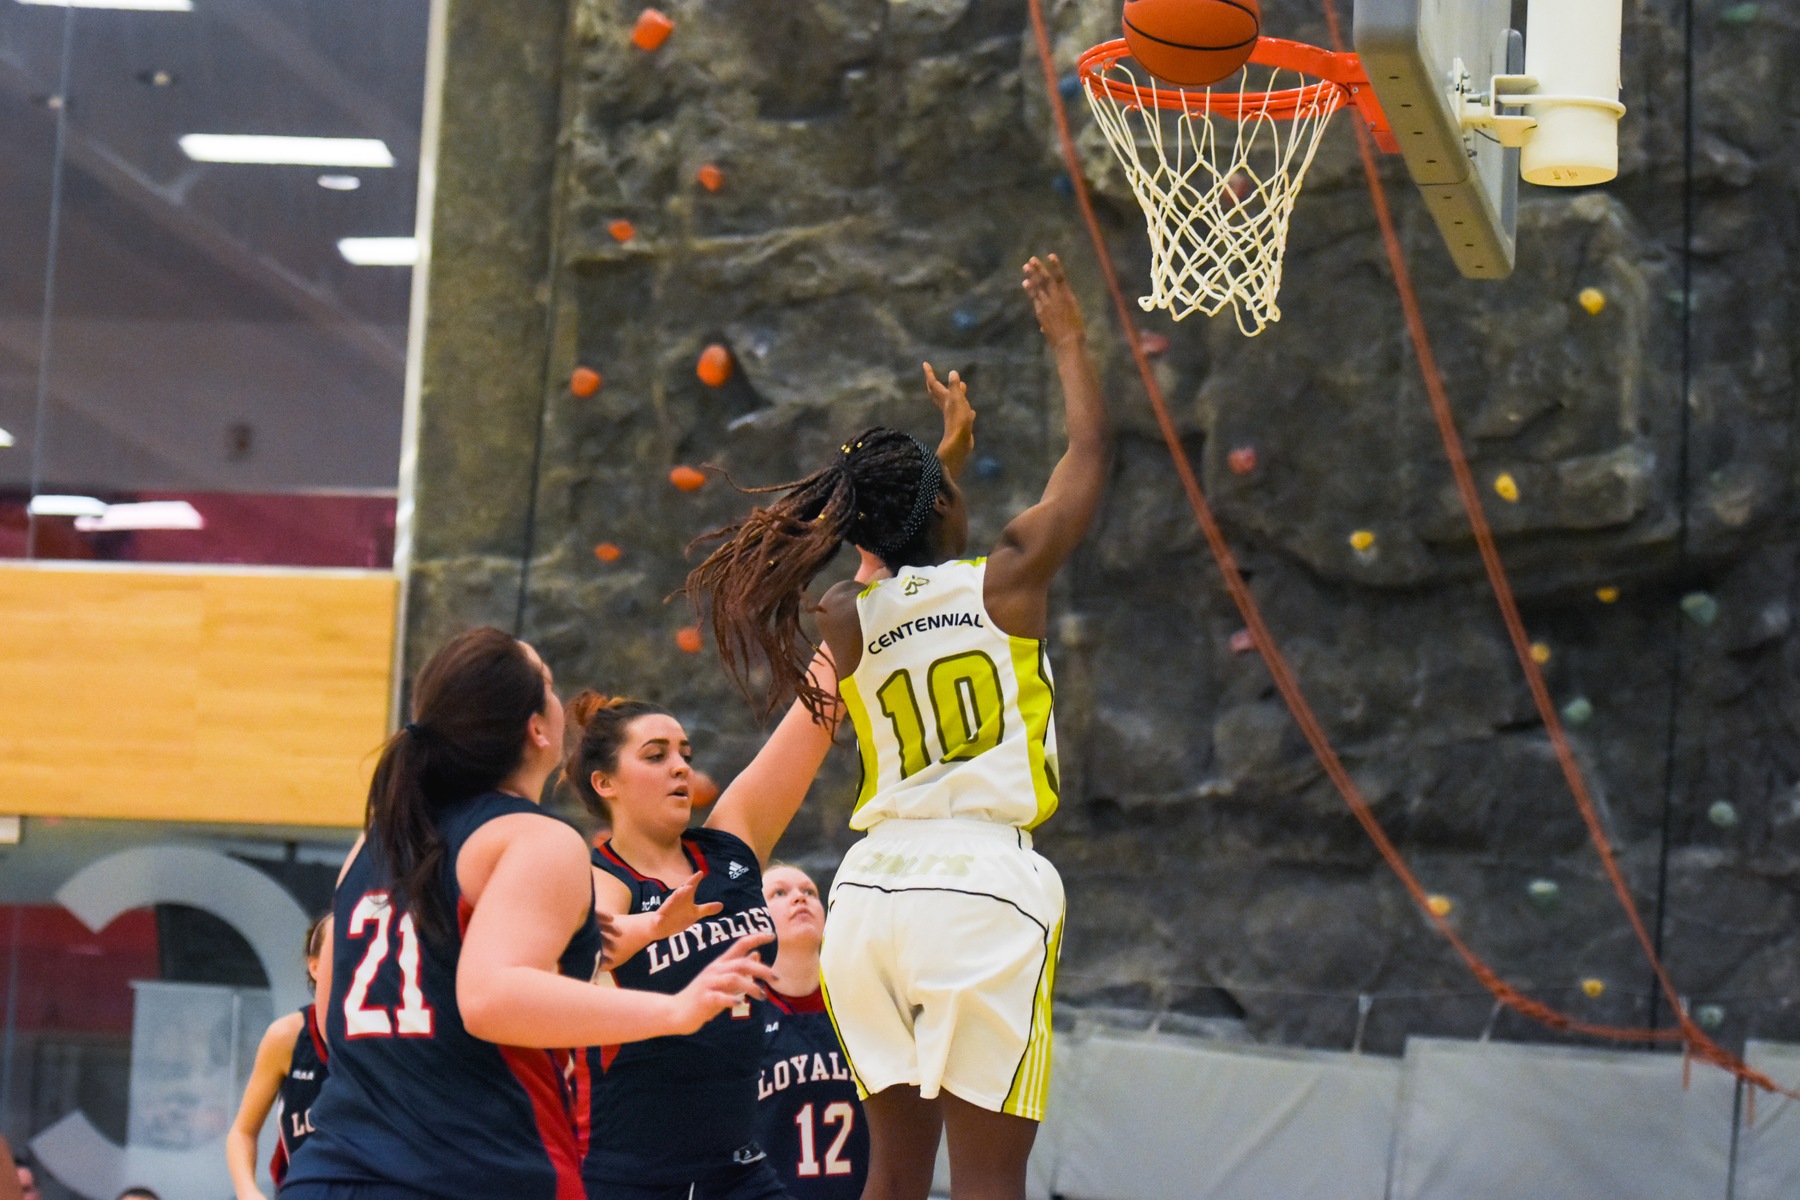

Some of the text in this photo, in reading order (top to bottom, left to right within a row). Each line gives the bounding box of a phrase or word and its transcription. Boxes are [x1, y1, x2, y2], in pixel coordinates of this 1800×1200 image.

[868, 612, 984, 655] CENTENNIAL
[876, 649, 1005, 780] 10
[344, 889, 435, 1040] 21
[646, 906, 774, 976] LOYALIS
[757, 1052, 854, 1101] LOYAL
[793, 1101, 855, 1178] 12
